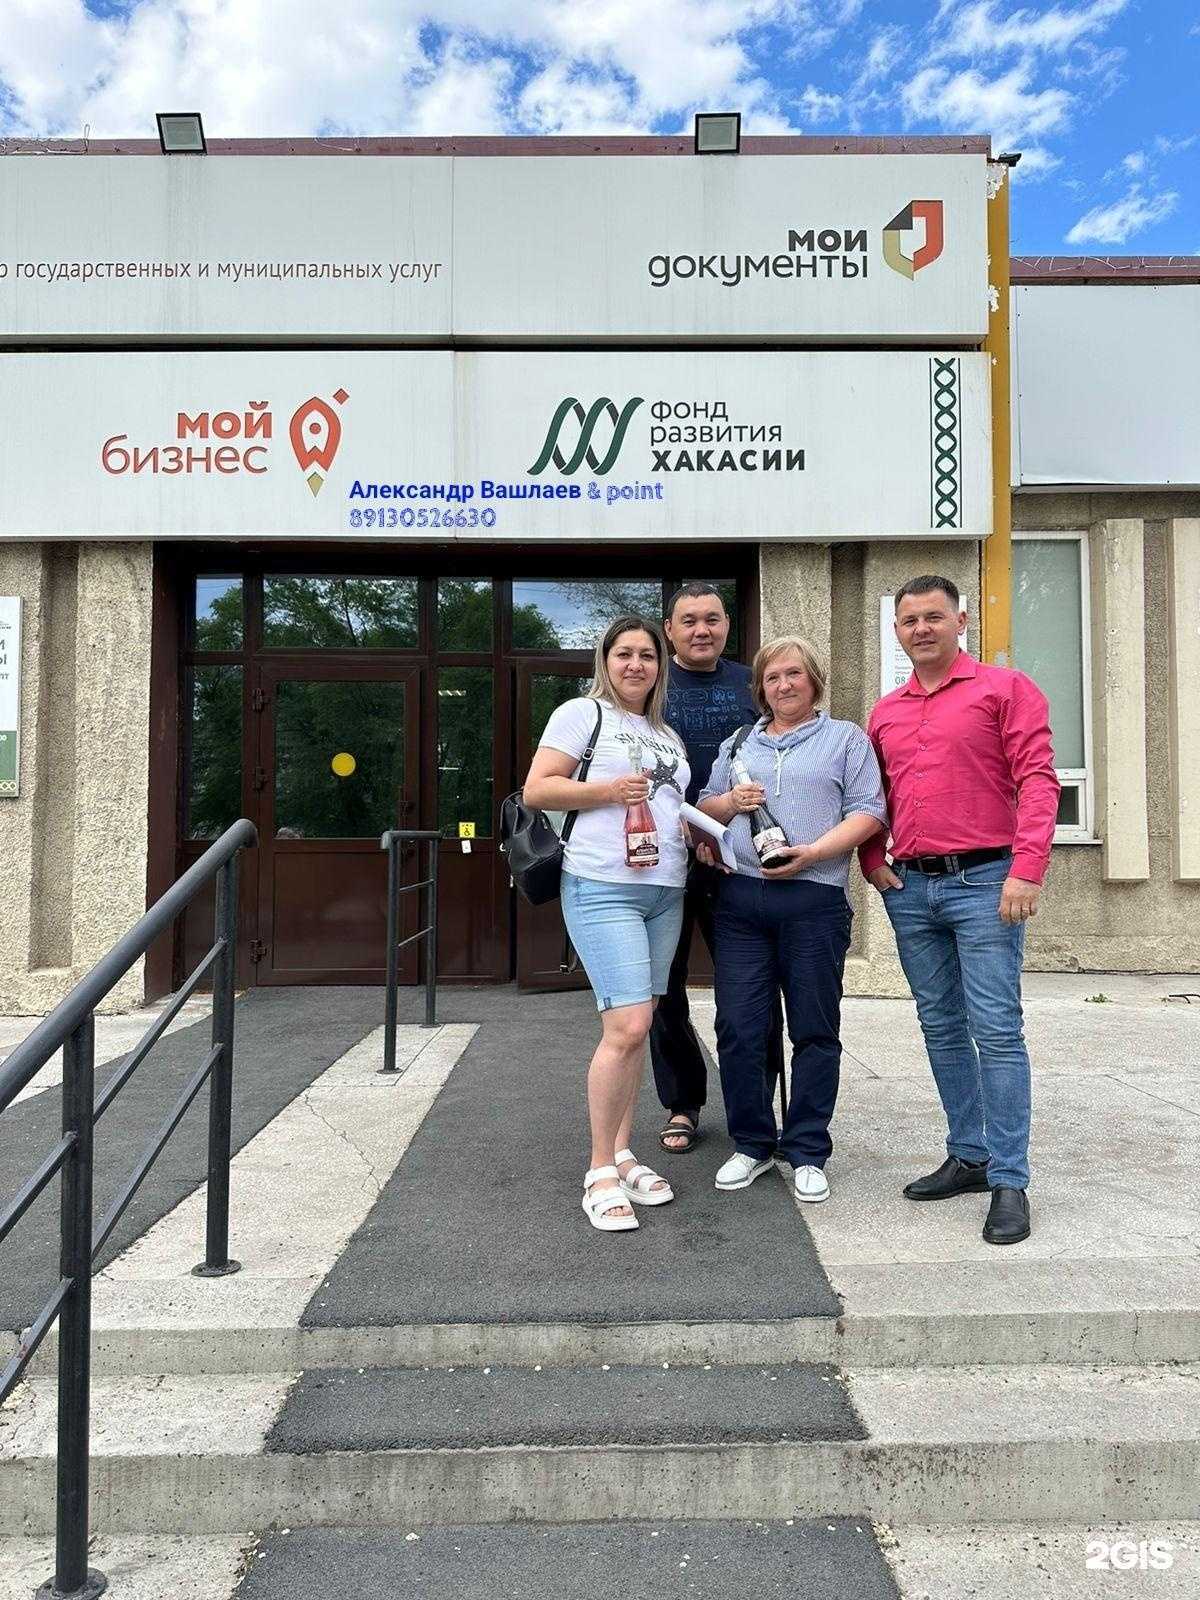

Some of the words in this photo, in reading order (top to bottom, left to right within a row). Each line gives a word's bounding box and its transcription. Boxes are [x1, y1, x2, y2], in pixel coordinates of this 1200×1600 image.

[16, 262, 191, 283] государственных
[198, 263, 209, 278] и
[217, 263, 382, 283] муниципальных
[389, 263, 442, 284] услуг
[648, 254, 868, 287] документы
[650, 425, 782, 447] развития
[101, 434, 268, 474] бизнес
[651, 449, 805, 472] ХАКАСИИ
